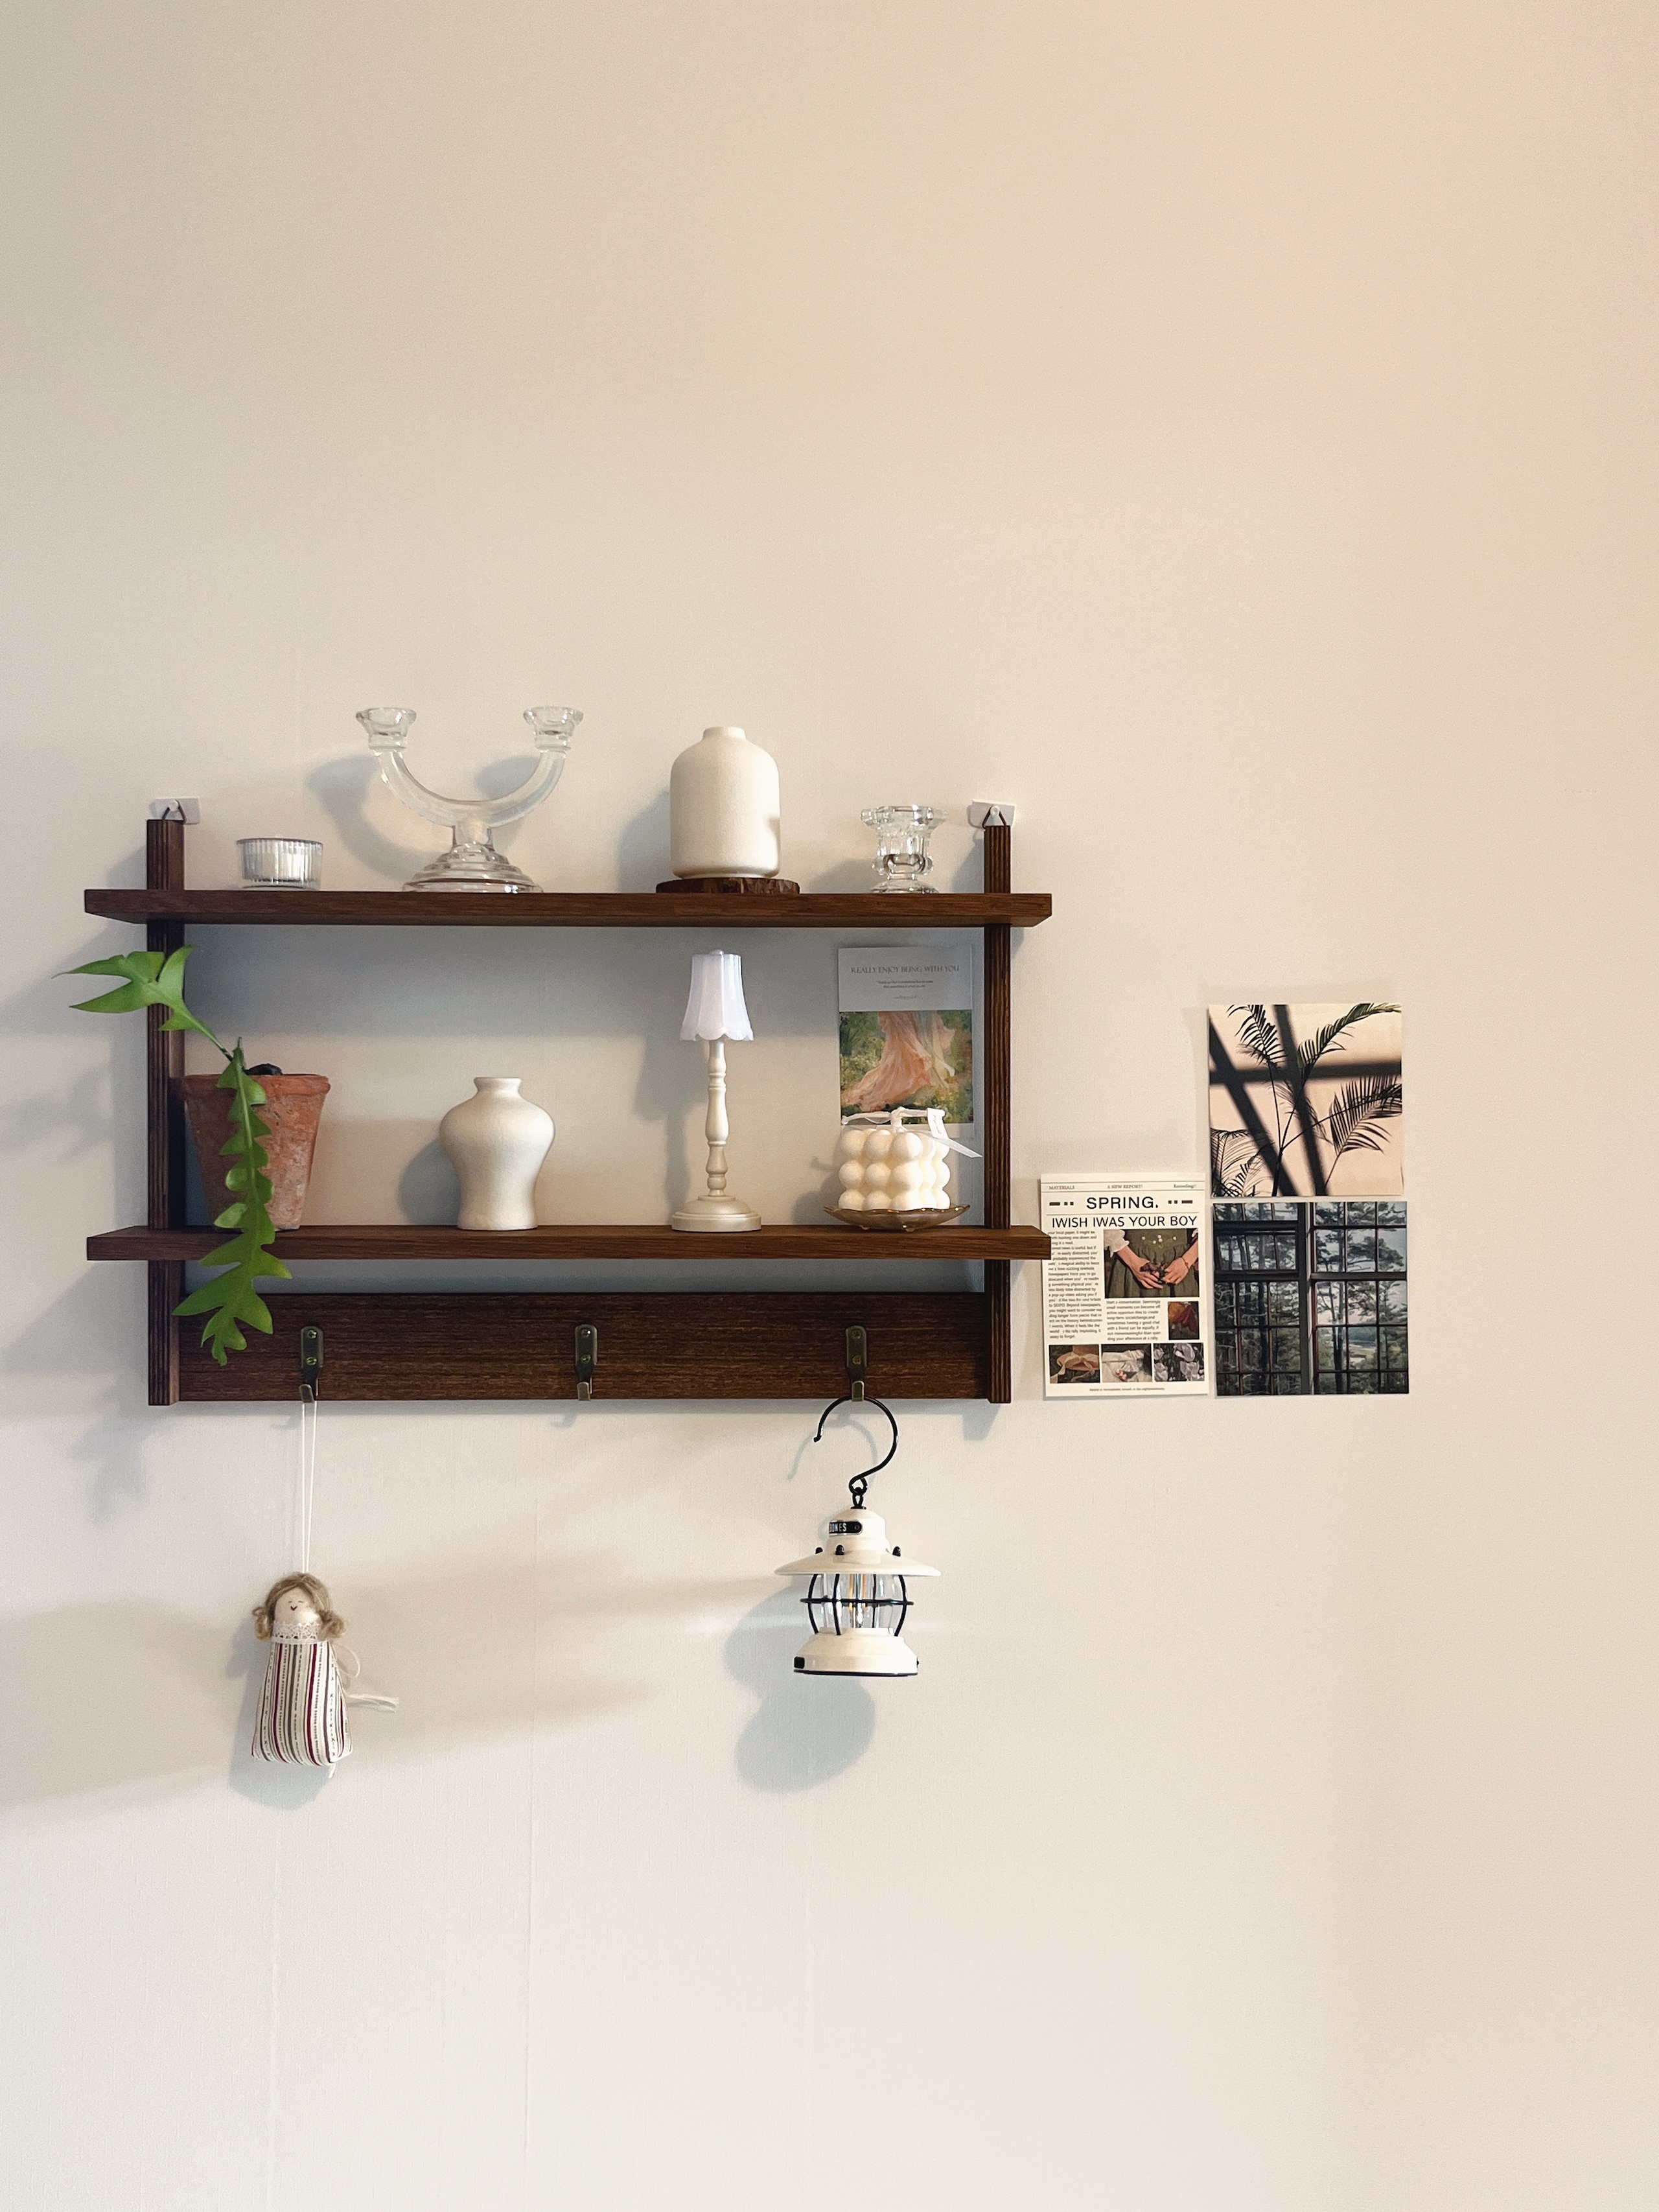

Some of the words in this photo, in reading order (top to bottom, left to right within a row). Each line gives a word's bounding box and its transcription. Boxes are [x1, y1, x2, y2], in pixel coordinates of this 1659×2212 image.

[1087, 1196, 1158, 1209] SPRING.
[1129, 1217, 1165, 1226] YOUR
[1170, 1215, 1197, 1226] BOY
